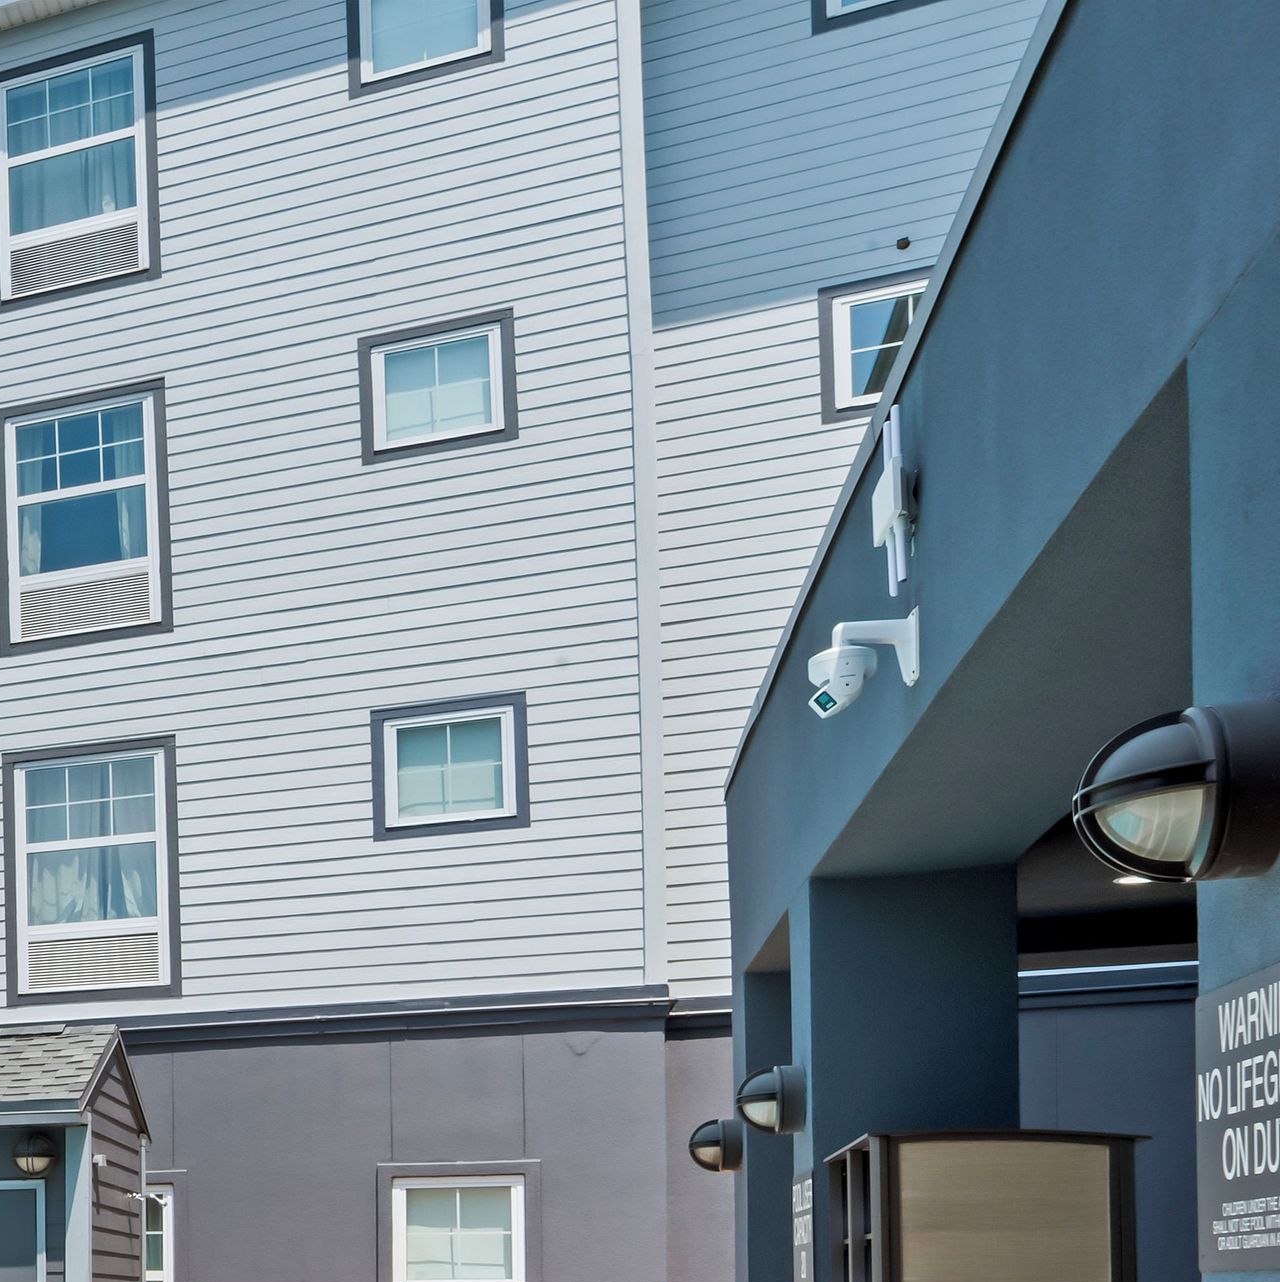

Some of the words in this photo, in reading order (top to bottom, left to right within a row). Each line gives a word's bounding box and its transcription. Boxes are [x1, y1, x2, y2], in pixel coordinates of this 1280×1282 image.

[1218, 981, 1280, 1053] WARNI
[1198, 1067, 1223, 1123] NO
[1227, 1049, 1280, 1116] LIFEG
[1222, 1125, 1249, 1181] ON
[1254, 1117, 1280, 1176] DU
